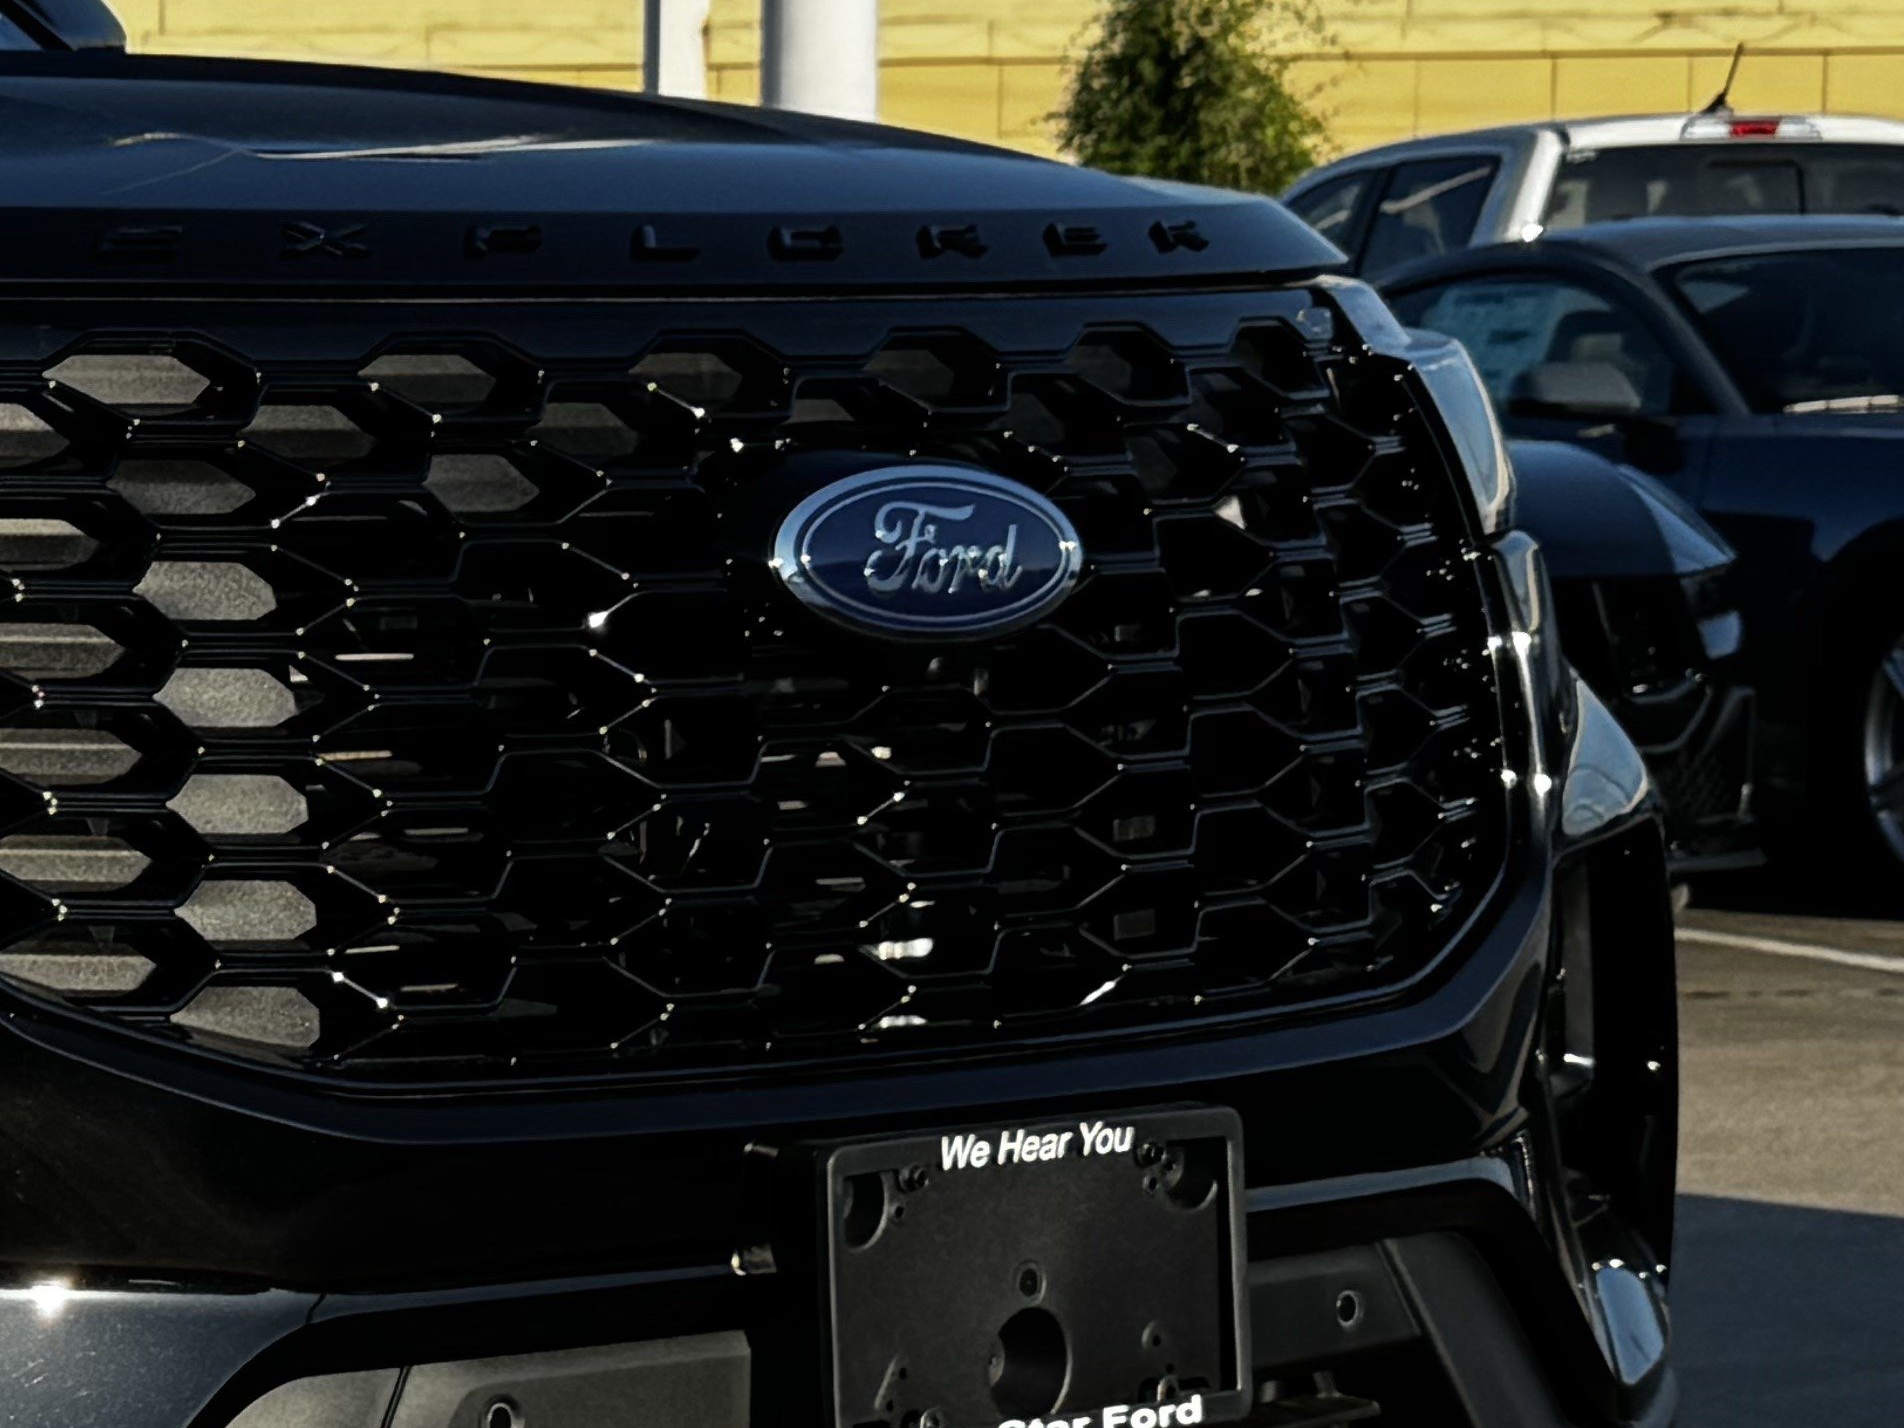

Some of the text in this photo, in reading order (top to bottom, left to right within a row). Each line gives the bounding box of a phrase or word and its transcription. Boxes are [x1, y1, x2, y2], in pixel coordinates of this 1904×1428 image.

[89, 218, 1209, 263] EXPLORER
[864, 501, 1022, 594] Ford
[942, 1121, 1134, 1170] We Hear You
